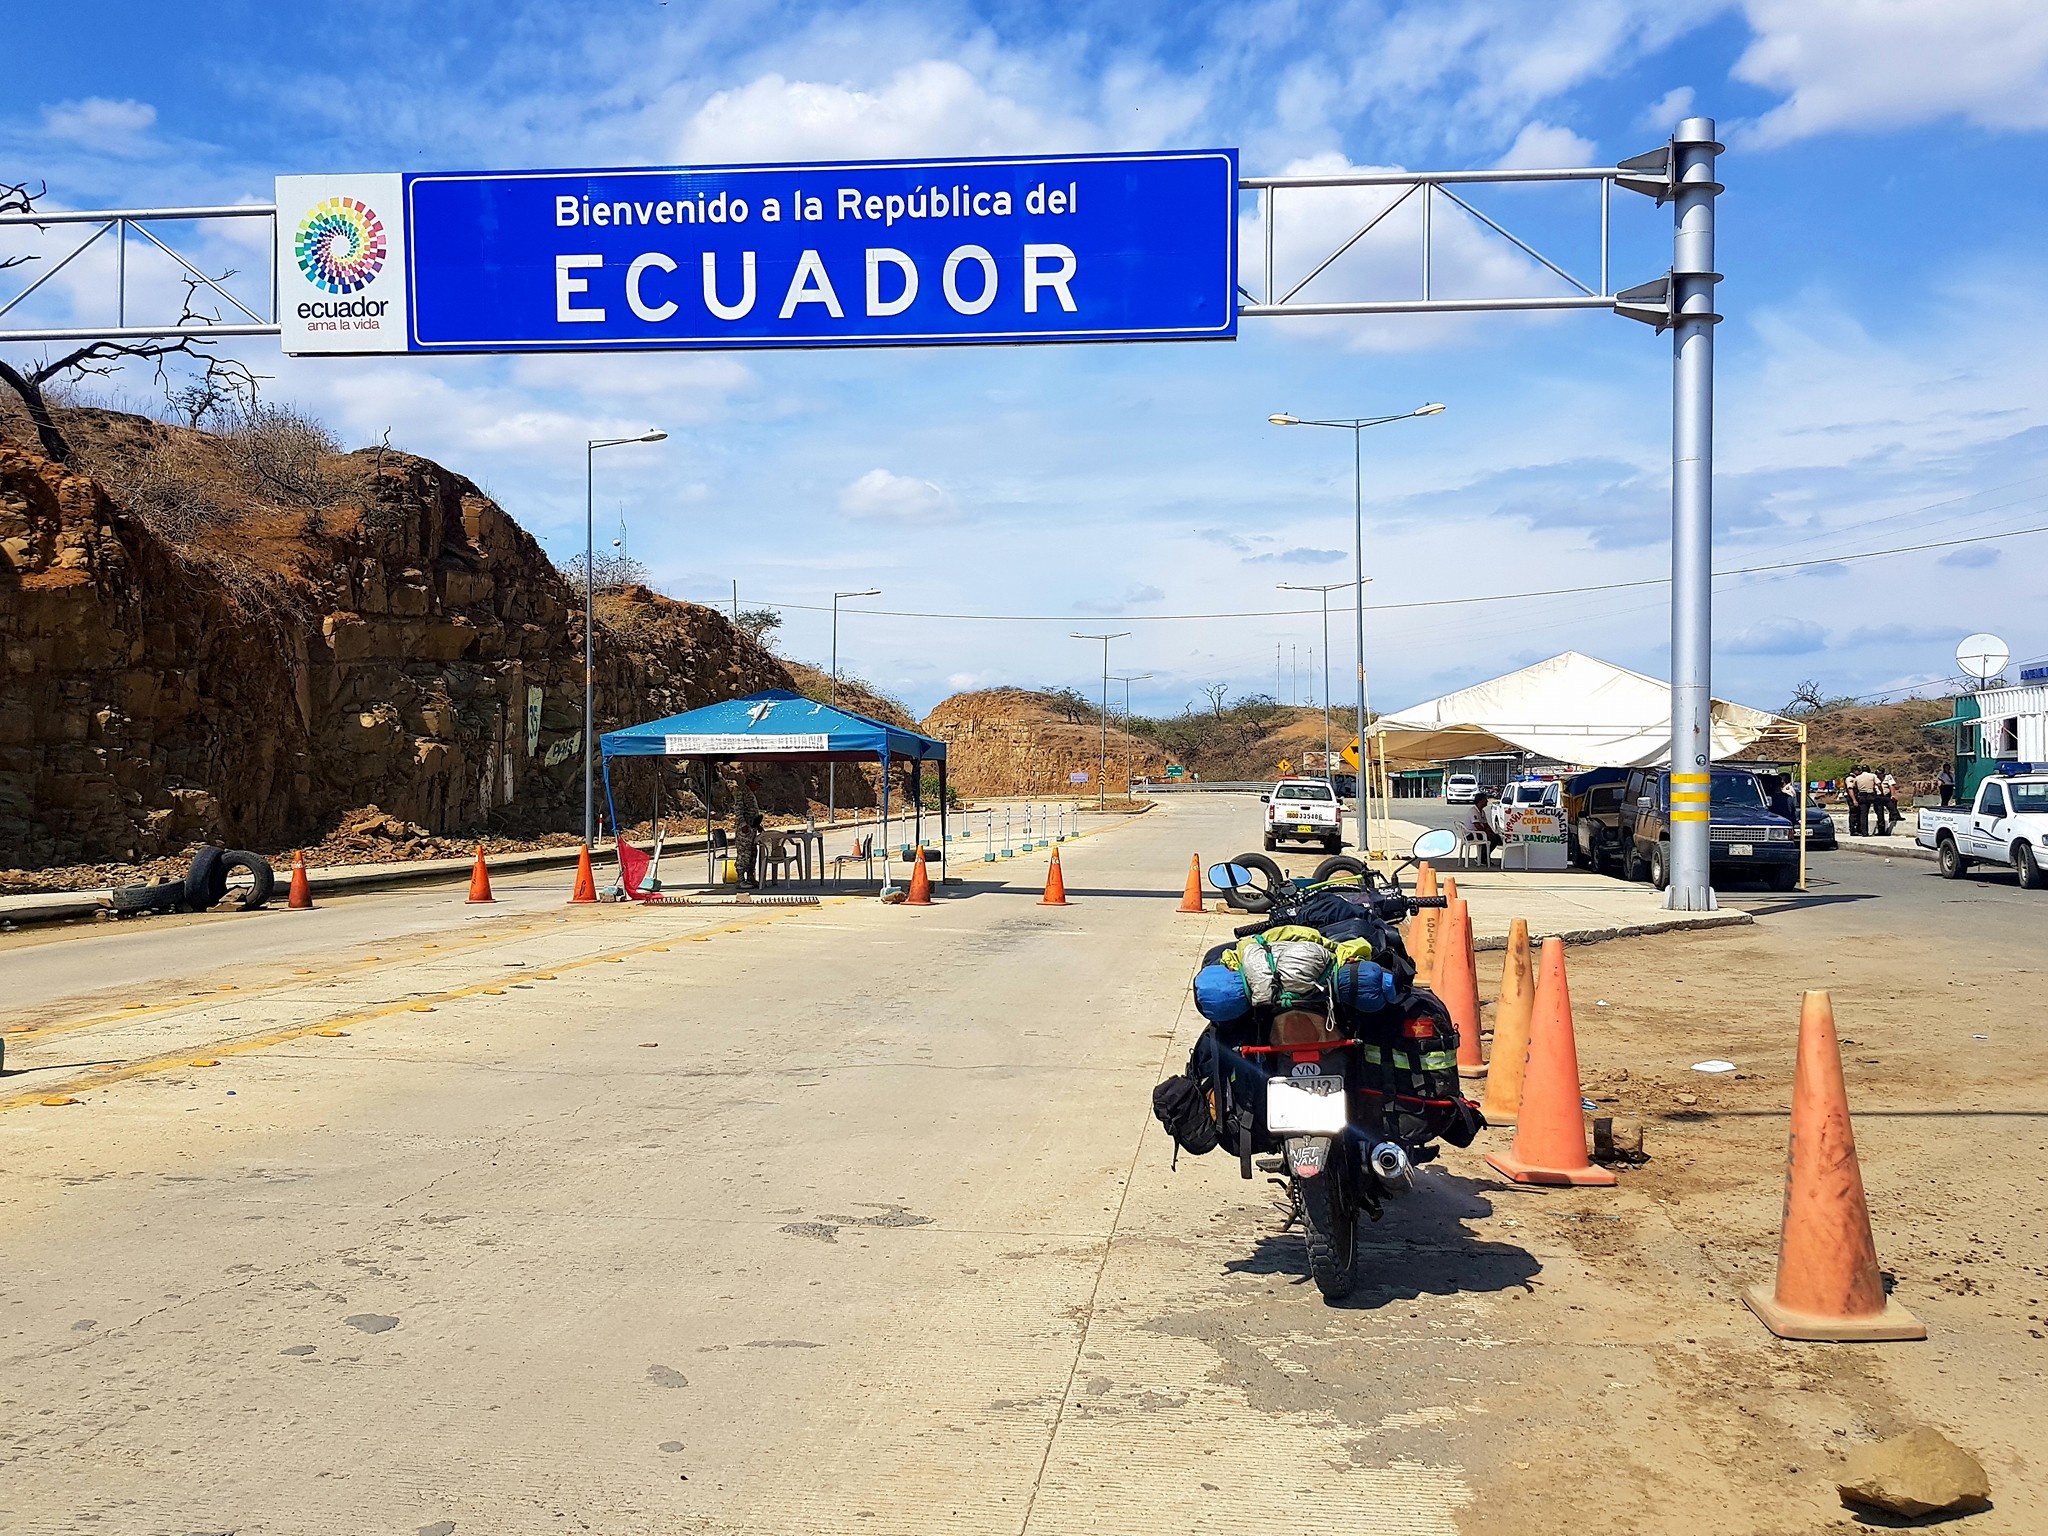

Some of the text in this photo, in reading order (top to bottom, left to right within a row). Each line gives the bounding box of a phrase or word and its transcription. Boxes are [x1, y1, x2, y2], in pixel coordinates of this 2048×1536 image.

[555, 181, 1077, 228] Bienvenido a la República del
[555, 243, 1079, 323] ECUADOR
[297, 295, 389, 319] ecuador
[307, 318, 380, 332] ama la vida
[1524, 808, 1534, 816] DE
[1522, 817, 1553, 825] CONTRA
[1296, 1065, 1316, 1076] VN
[1290, 1146, 1320, 1160] VIET
[1293, 1156, 1319, 1168] NAM
